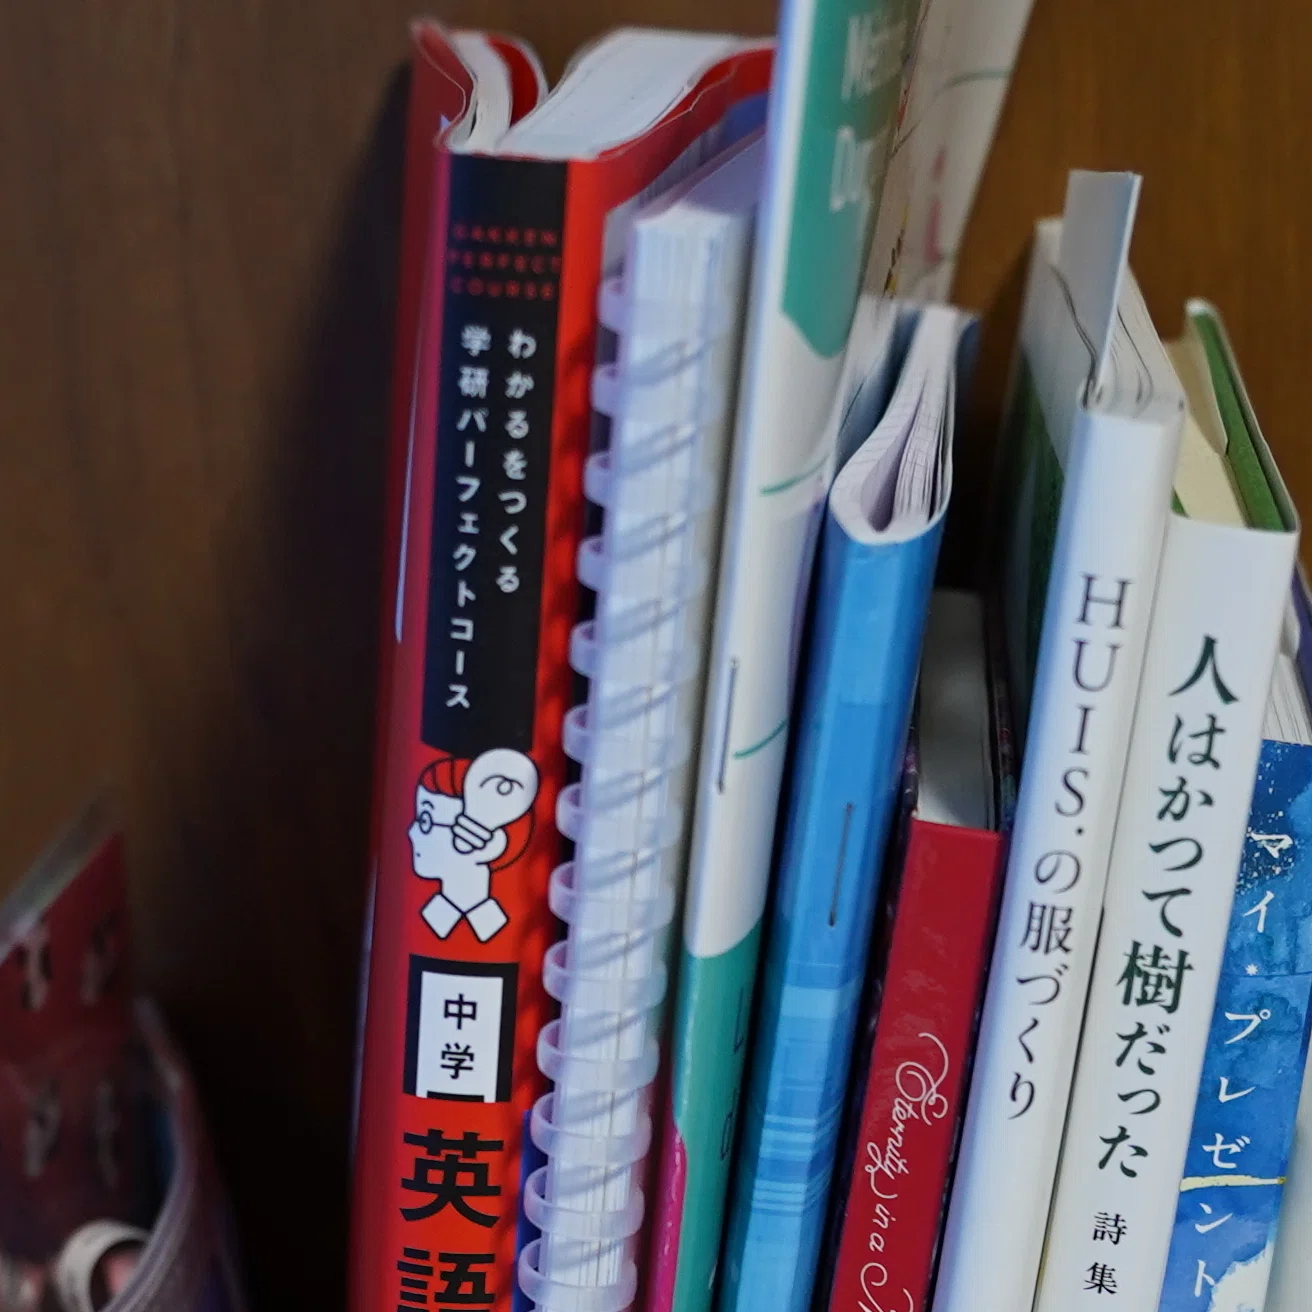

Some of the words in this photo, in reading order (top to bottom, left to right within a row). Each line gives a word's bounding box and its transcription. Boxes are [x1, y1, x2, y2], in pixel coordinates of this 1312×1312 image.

[496, 329, 538, 593] わかるをつくる
[445, 324, 491, 710] 学研パーフェクトコース
[1096, 634, 1240, 1179] 人はかつて樹だった
[438, 993, 479, 1080] 中学
[869, 1231, 886, 1252] a
[873, 1203, 897, 1229] in
[1082, 1211, 1129, 1295] 詩集
